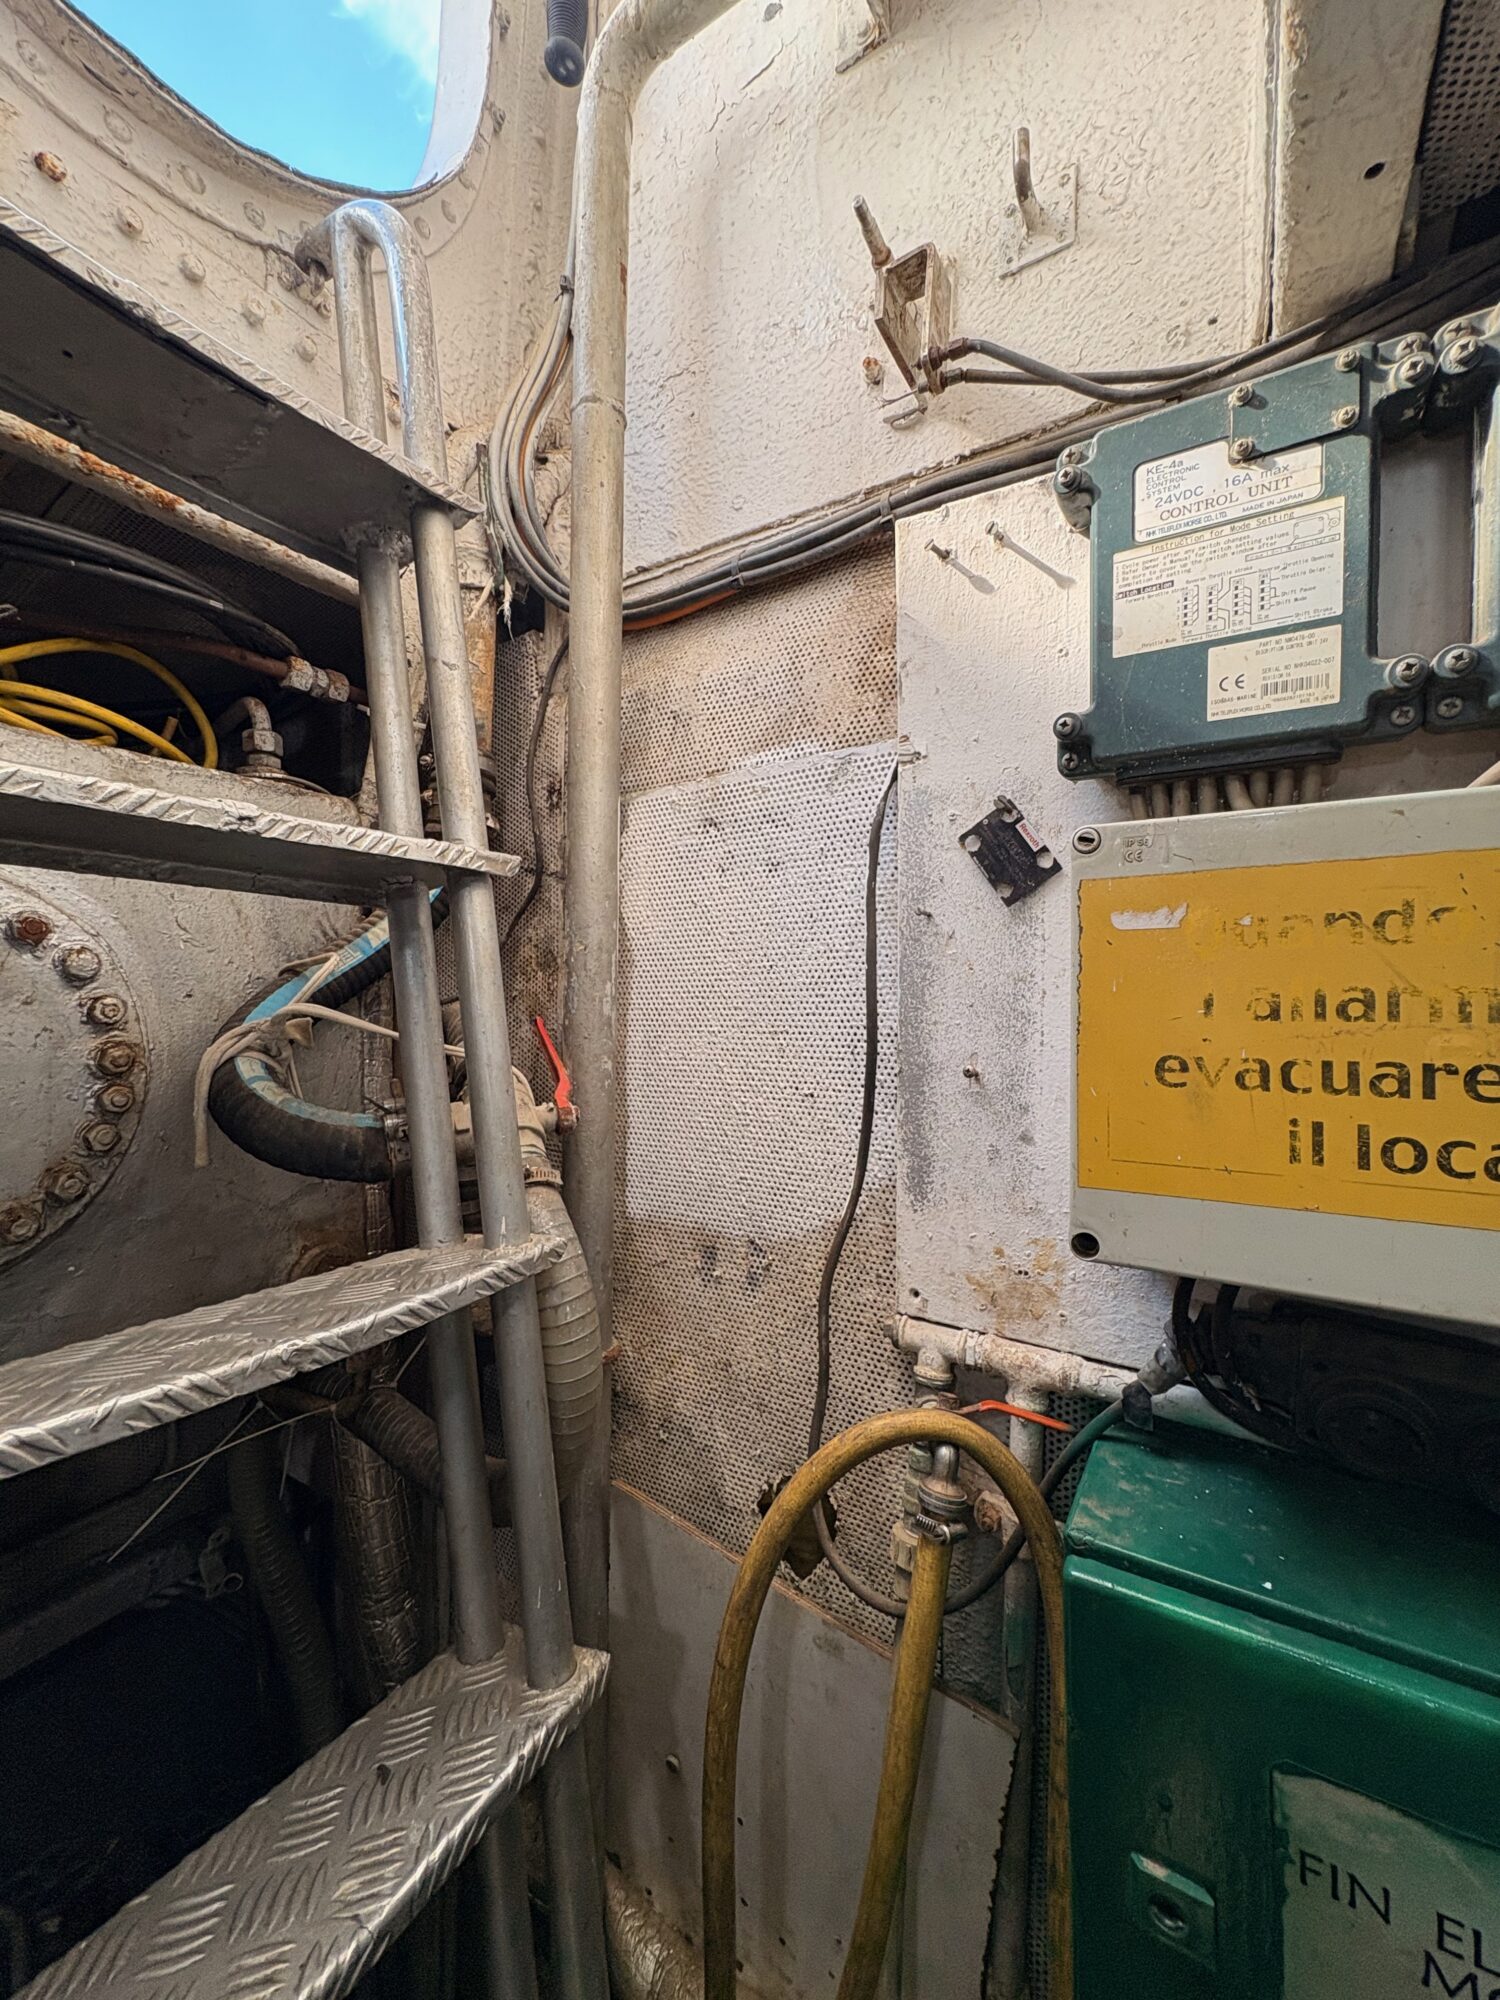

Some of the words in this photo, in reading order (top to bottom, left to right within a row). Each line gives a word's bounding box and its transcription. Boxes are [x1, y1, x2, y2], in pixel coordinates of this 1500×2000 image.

[1146, 459, 1184, 476] KE-4a
[1146, 463, 1200, 484] ELECTRONIC
[1146, 476, 1186, 491] CONTROL
[1146, 483, 1181, 498] SYSTEM
[1155, 485, 1204, 508] 24VDC
[1224, 473, 1253, 489] 16A
[1260, 463, 1290, 480] max
[1160, 491, 1239, 522] CONTROL
[1248, 475, 1294, 498] UNIT
[1242, 501, 1265, 513] MADE
[1276, 492, 1304, 505] JAPAN
[1151, 534, 1205, 553] Instruction
[1209, 528, 1224, 539] for
[1229, 521, 1251, 533] Mode
[1256, 511, 1295, 527] Setting
[1183, 517, 1203, 529] MORSE
[1018, 822, 1040, 849] Rexroth
[1289, 1117, 1325, 1167] il
[1300, 1850, 1391, 1926] FIN
